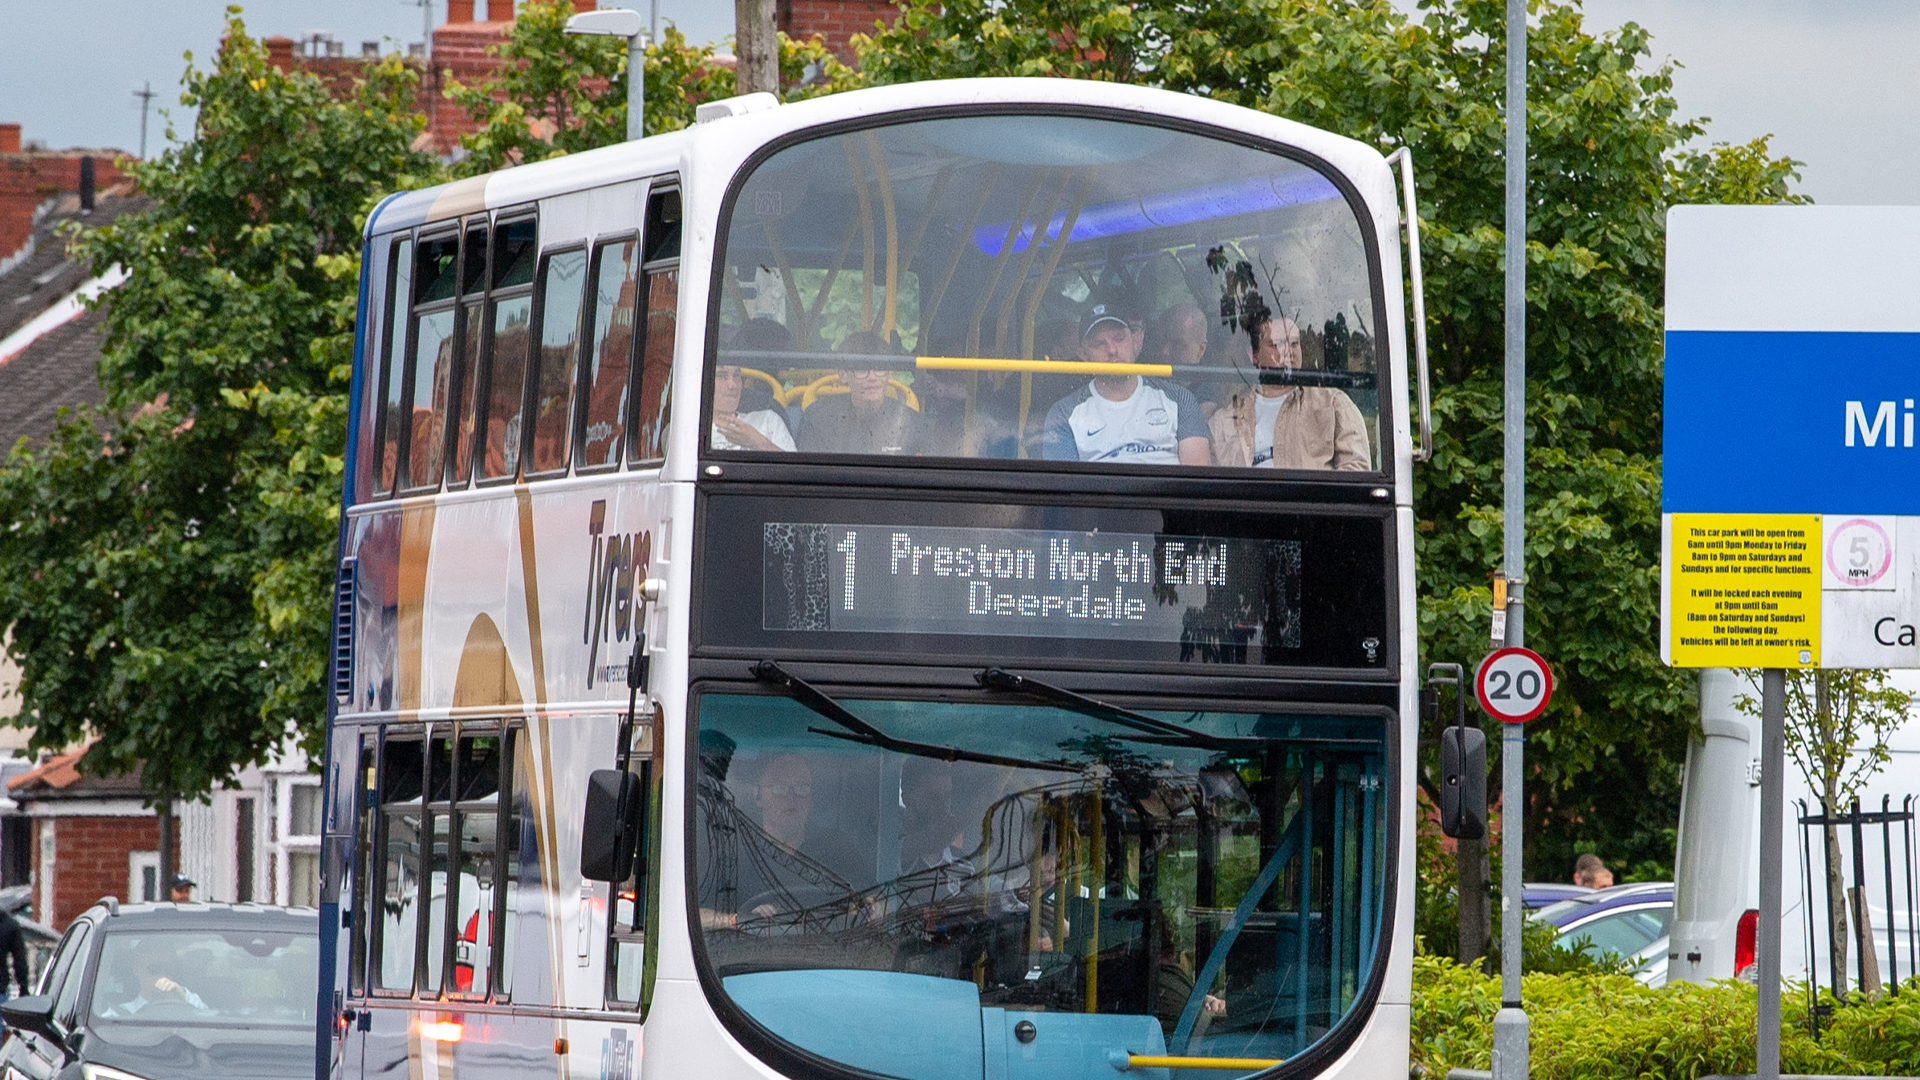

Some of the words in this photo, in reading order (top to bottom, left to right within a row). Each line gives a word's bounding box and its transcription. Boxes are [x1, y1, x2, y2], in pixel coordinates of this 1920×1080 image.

[1845, 398, 1914, 448] Mi
[1690, 528, 1706, 536] This
[1722, 529, 1738, 538] park
[1740, 528, 1754, 537] will
[1756, 529, 1765, 537] be
[1787, 529, 1804, 538] from
[1688, 540, 1704, 548] 6am
[1706, 540, 1724, 549] until
[1725, 540, 1742, 550] 9pm
[1744, 540, 1773, 550] Monday
[1784, 541, 1807, 550] Friday
[1692, 552, 1708, 560] 8am
[1710, 553, 1718, 561] to
[1719, 552, 1736, 562] 9pm
[1748, 553, 1786, 562] Saturdays
[1788, 553, 1802, 562] and
[1849, 536, 1869, 568] 5
[837, 531, 856, 610] 1
[891, 533, 1035, 580] Preston
[1049, 538, 1150, 583] North
[1165, 542, 1226, 586] End
[1681, 564, 1713, 574] Sundays
[1715, 565, 1729, 573] and
[1731, 565, 1741, 573] for
[1743, 565, 1773, 574] specific
[1775, 565, 1812, 574] functions.
[1848, 569, 1869, 578] MPH
[1691, 589, 1696, 597] It
[1698, 589, 1712, 597] will
[1713, 589, 1723, 598] be
[1724, 589, 1750, 598] locked
[1752, 590, 1770, 598] each
[1772, 590, 1802, 599] evening
[1724, 601, 1741, 610] 9pm
[1742, 602, 1760, 610] until
[1761, 601, 1778, 610] 6am
[1687, 613, 1706, 622] (8am
[1720, 613, 1753, 623] Saturday
[1754, 614, 1768, 622] and
[1770, 614, 1805, 623] Sundays)
[1713, 625, 1725, 634] the
[1727, 626, 1762, 635] following
[1764, 626, 1778, 635] day.
[1874, 616, 1916, 646] Ca
[1680, 637, 1713, 646] Vehicles
[1714, 638, 1728, 646] will
[1730, 638, 1739, 646] be
[1741, 638, 1754, 646] left
[1755, 638, 1762, 646] at
[1764, 638, 1794, 646] owner's
[1795, 638, 1811, 647] risk.
[1489, 670, 1541, 700] 20
